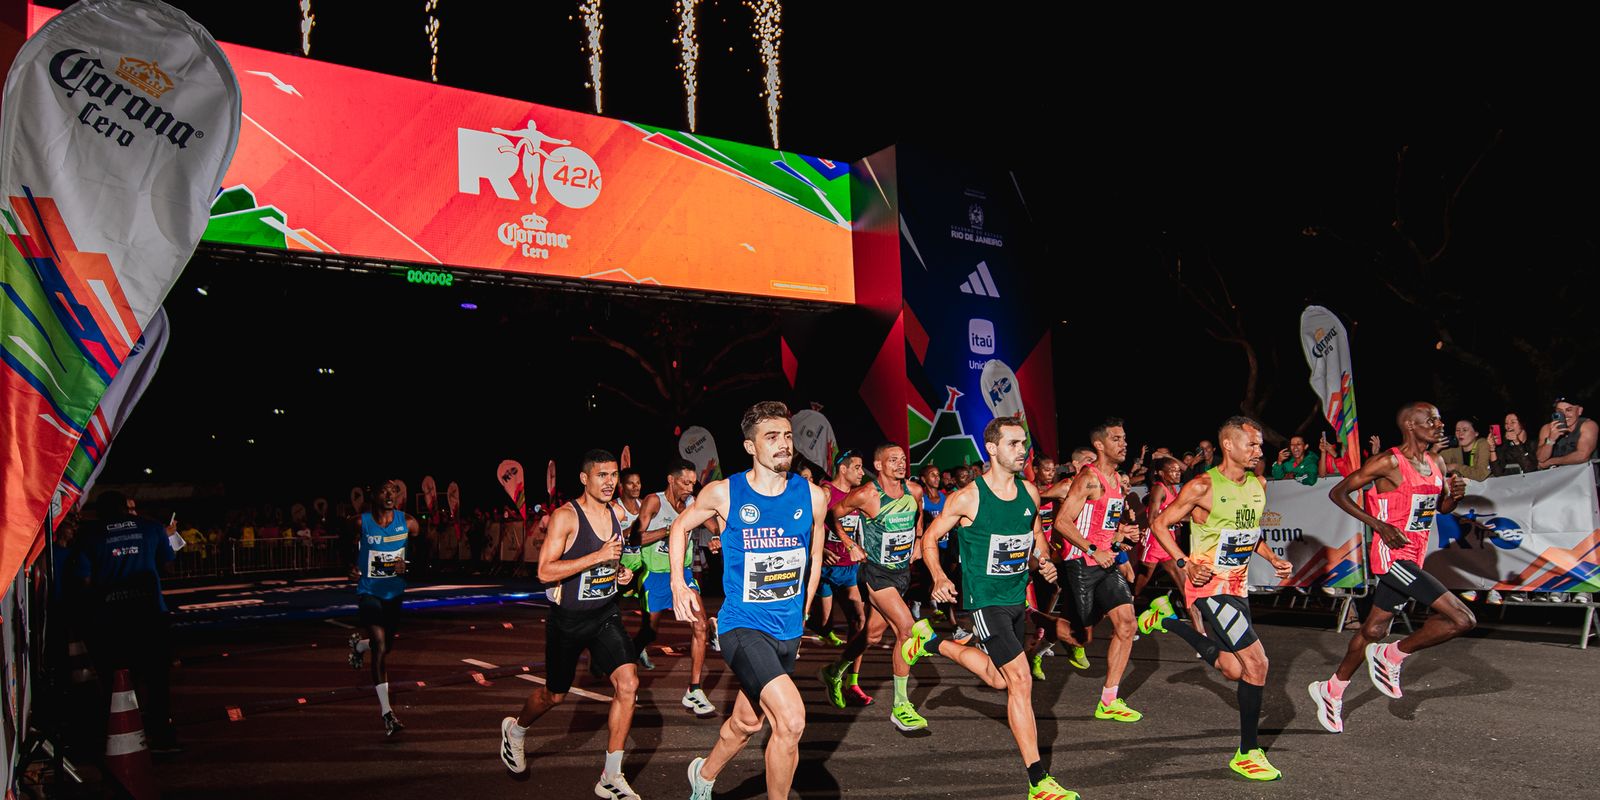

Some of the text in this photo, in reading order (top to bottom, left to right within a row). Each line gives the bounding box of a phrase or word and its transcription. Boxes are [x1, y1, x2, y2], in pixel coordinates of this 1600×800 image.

[49, 48, 195, 149] Corona
[78, 102, 135, 147] Cero
[497, 222, 569, 249] Corona
[951, 230, 1003, 247] RIO DE JANEIRO
[521, 243, 549, 260] Cero
[971, 332, 993, 348] itaú
[1235, 508, 1256, 521] #VOA
[742, 527, 777, 539] ELITE
[1262, 527, 1304, 542] rona
[743, 536, 798, 550] RUNNERS
[1009, 551, 1025, 559] VITOR
[763, 571, 797, 582] EDERSON
